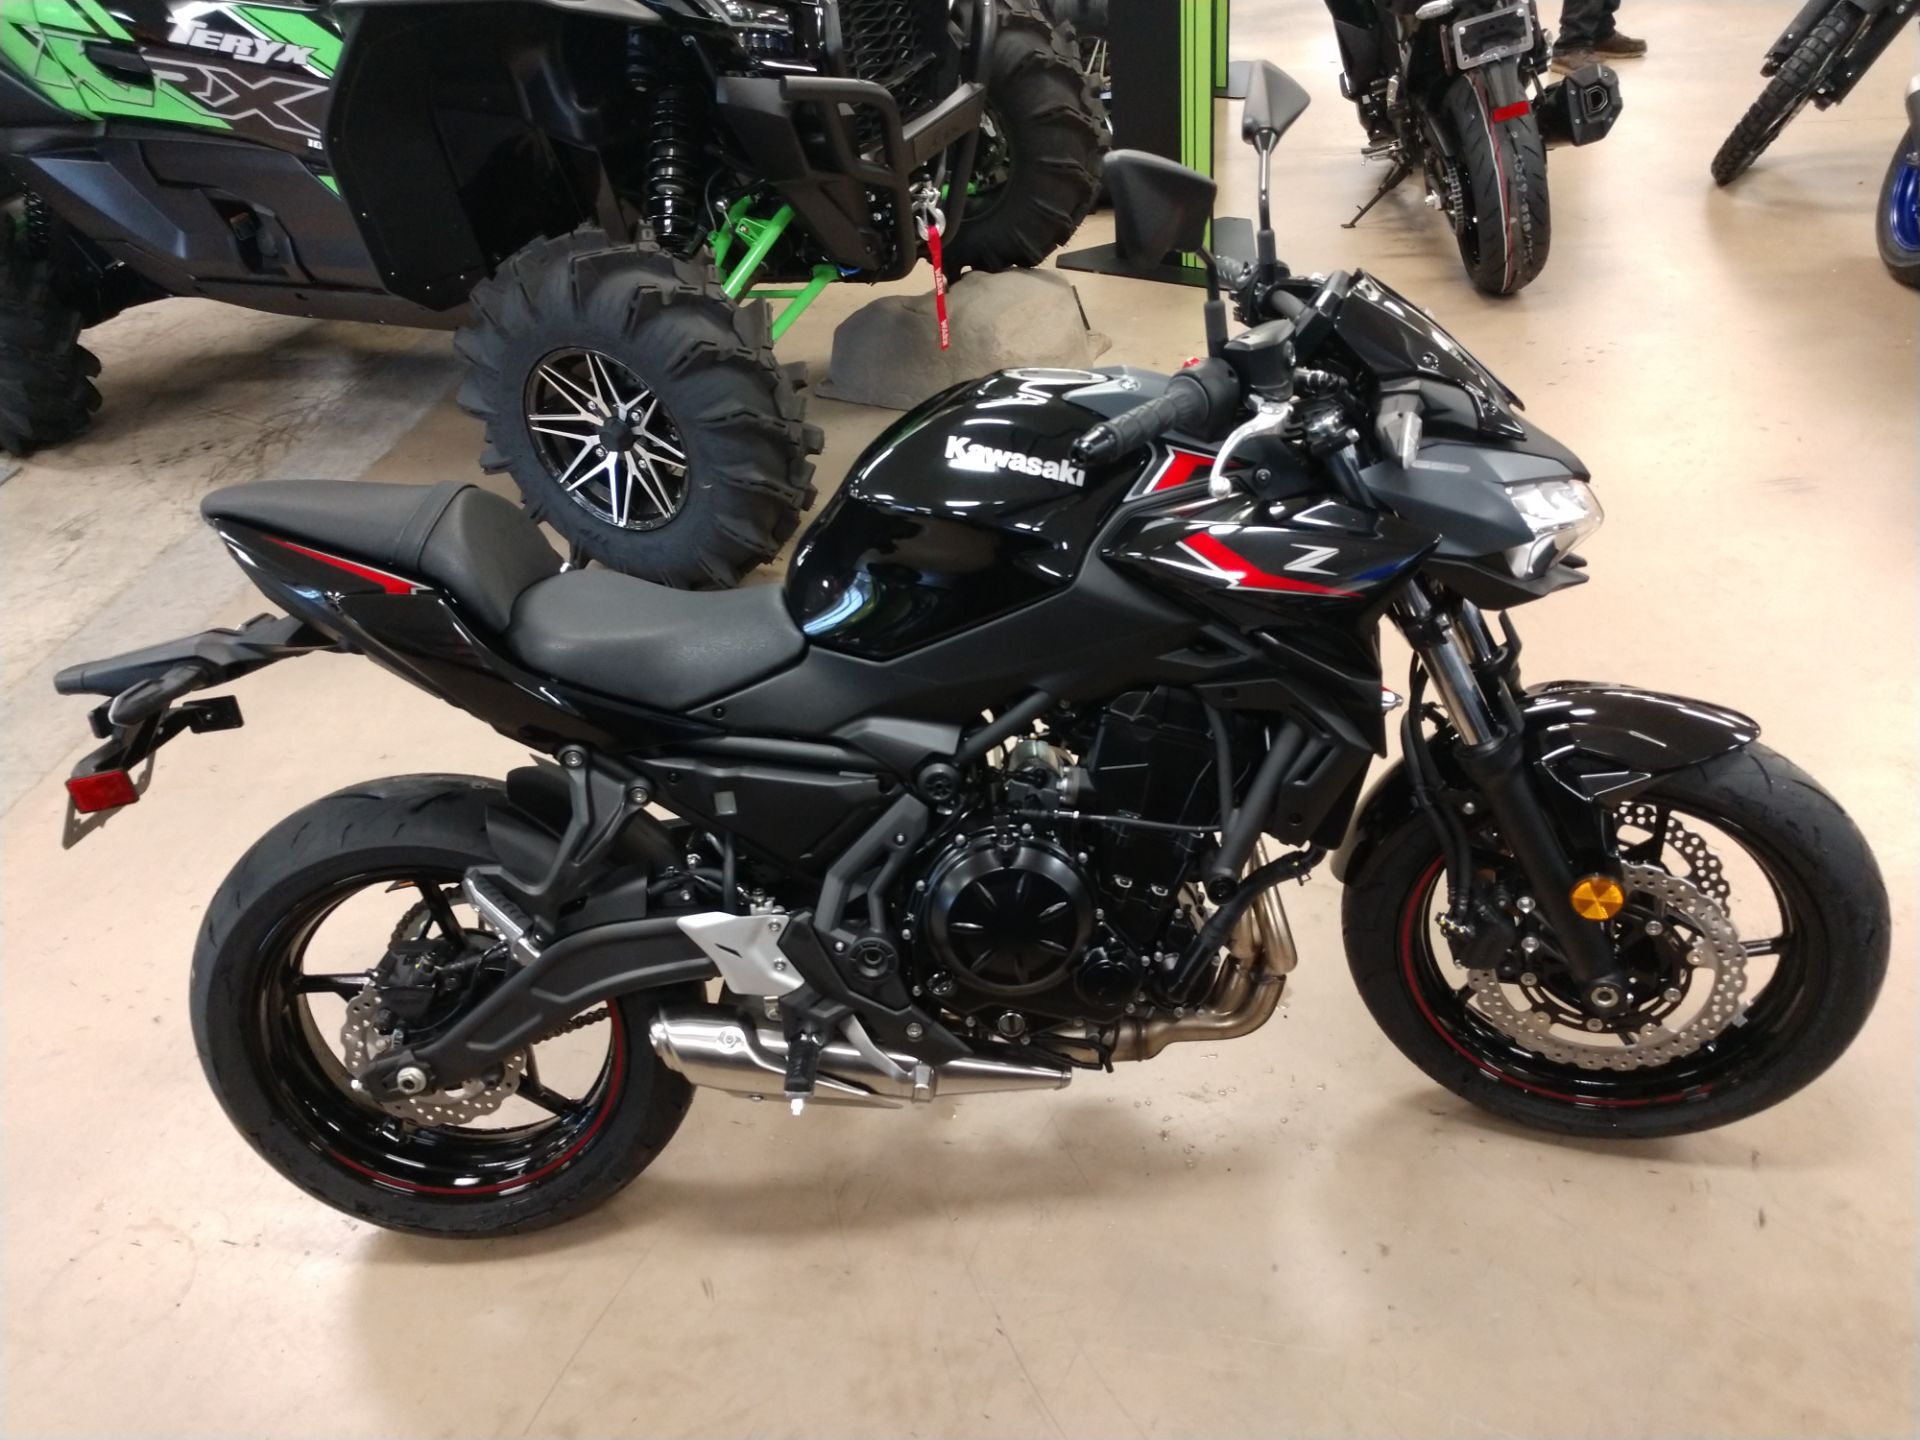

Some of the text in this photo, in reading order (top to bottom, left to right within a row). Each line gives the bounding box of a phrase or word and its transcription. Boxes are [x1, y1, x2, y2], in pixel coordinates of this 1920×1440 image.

[166, 14, 321, 65] TERYX
[943, 435, 1087, 487] Kawasaki
[1283, 543, 1340, 576] Z
